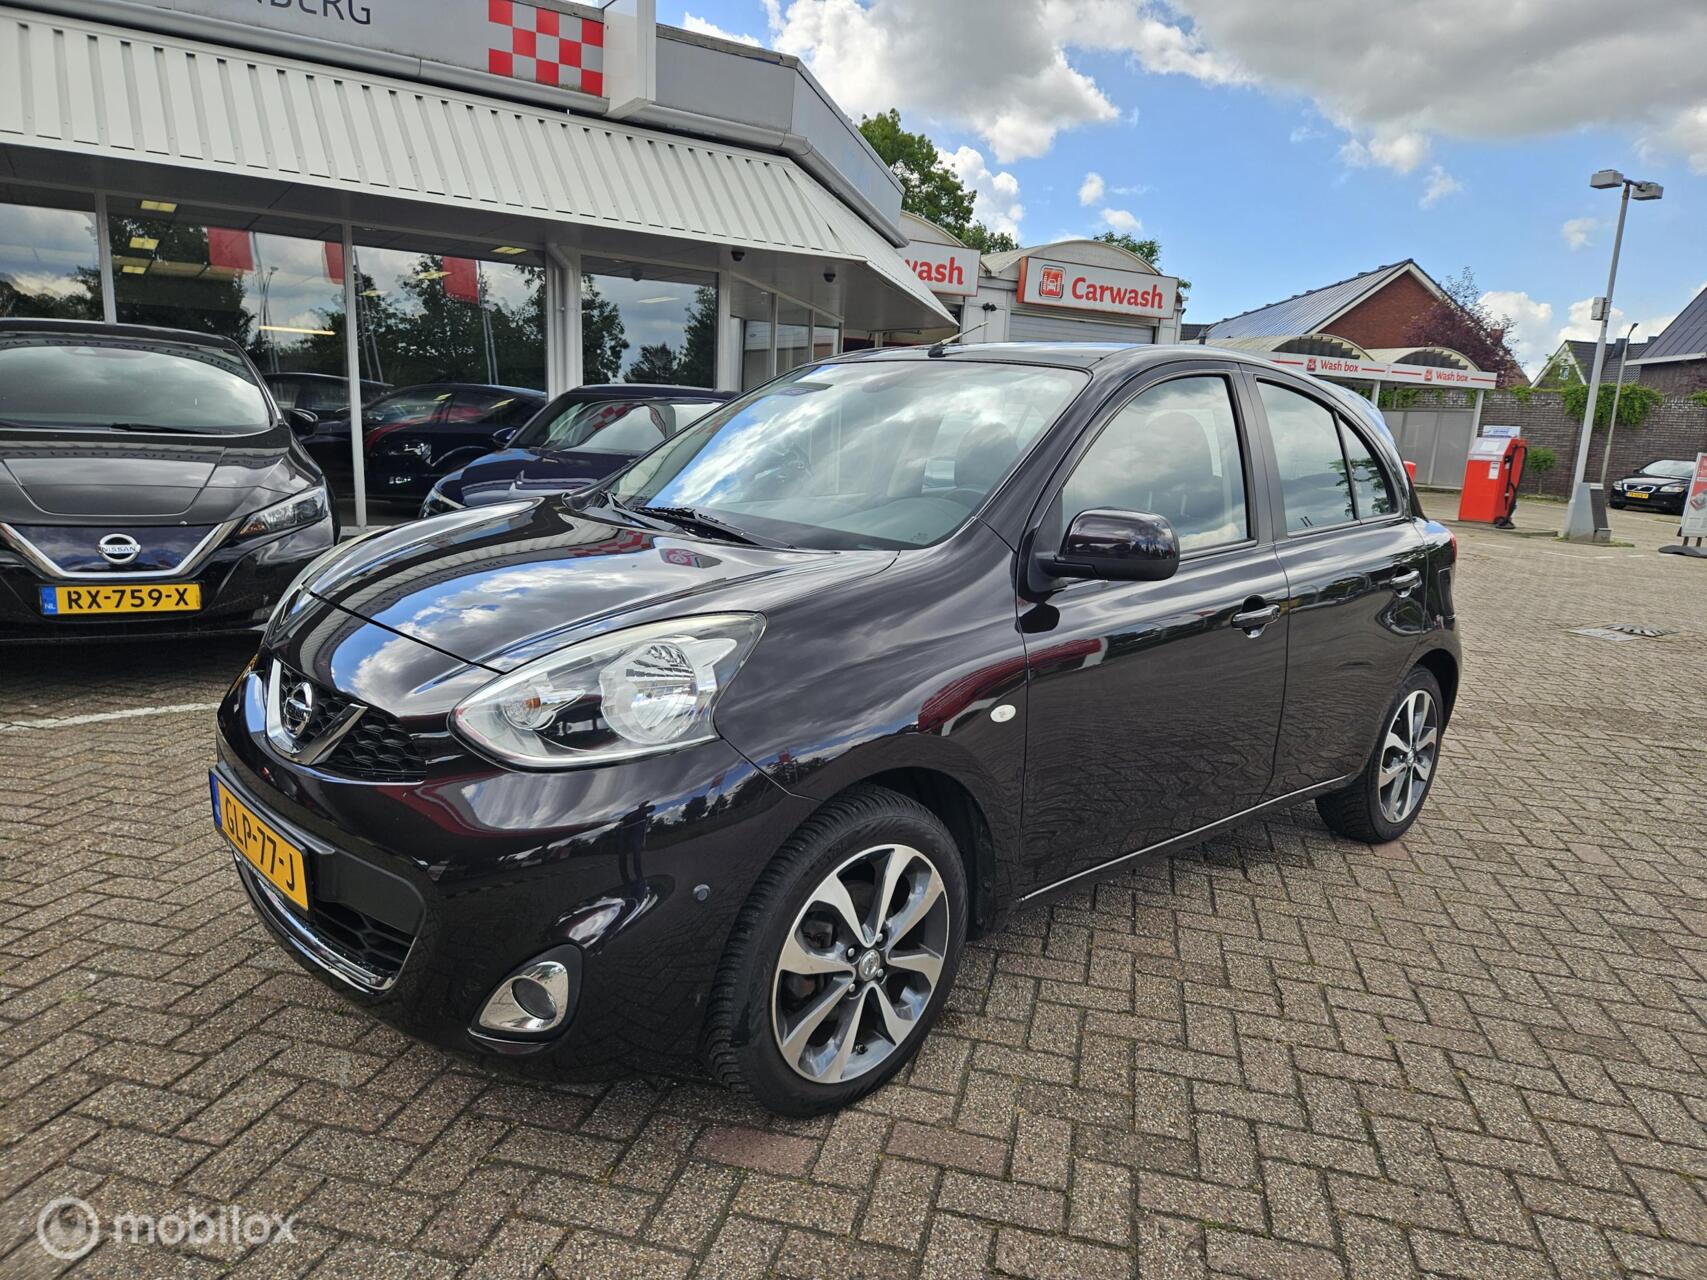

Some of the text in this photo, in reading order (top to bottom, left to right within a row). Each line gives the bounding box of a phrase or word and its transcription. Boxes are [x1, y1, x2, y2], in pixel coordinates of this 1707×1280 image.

[1071, 276, 1164, 309] Carwash
[1320, 360, 1359, 373] Wash box
[1436, 370, 1469, 382] Wash box
[67, 587, 189, 610] RX-759-X
[225, 796, 295, 891] GLP-77-J
